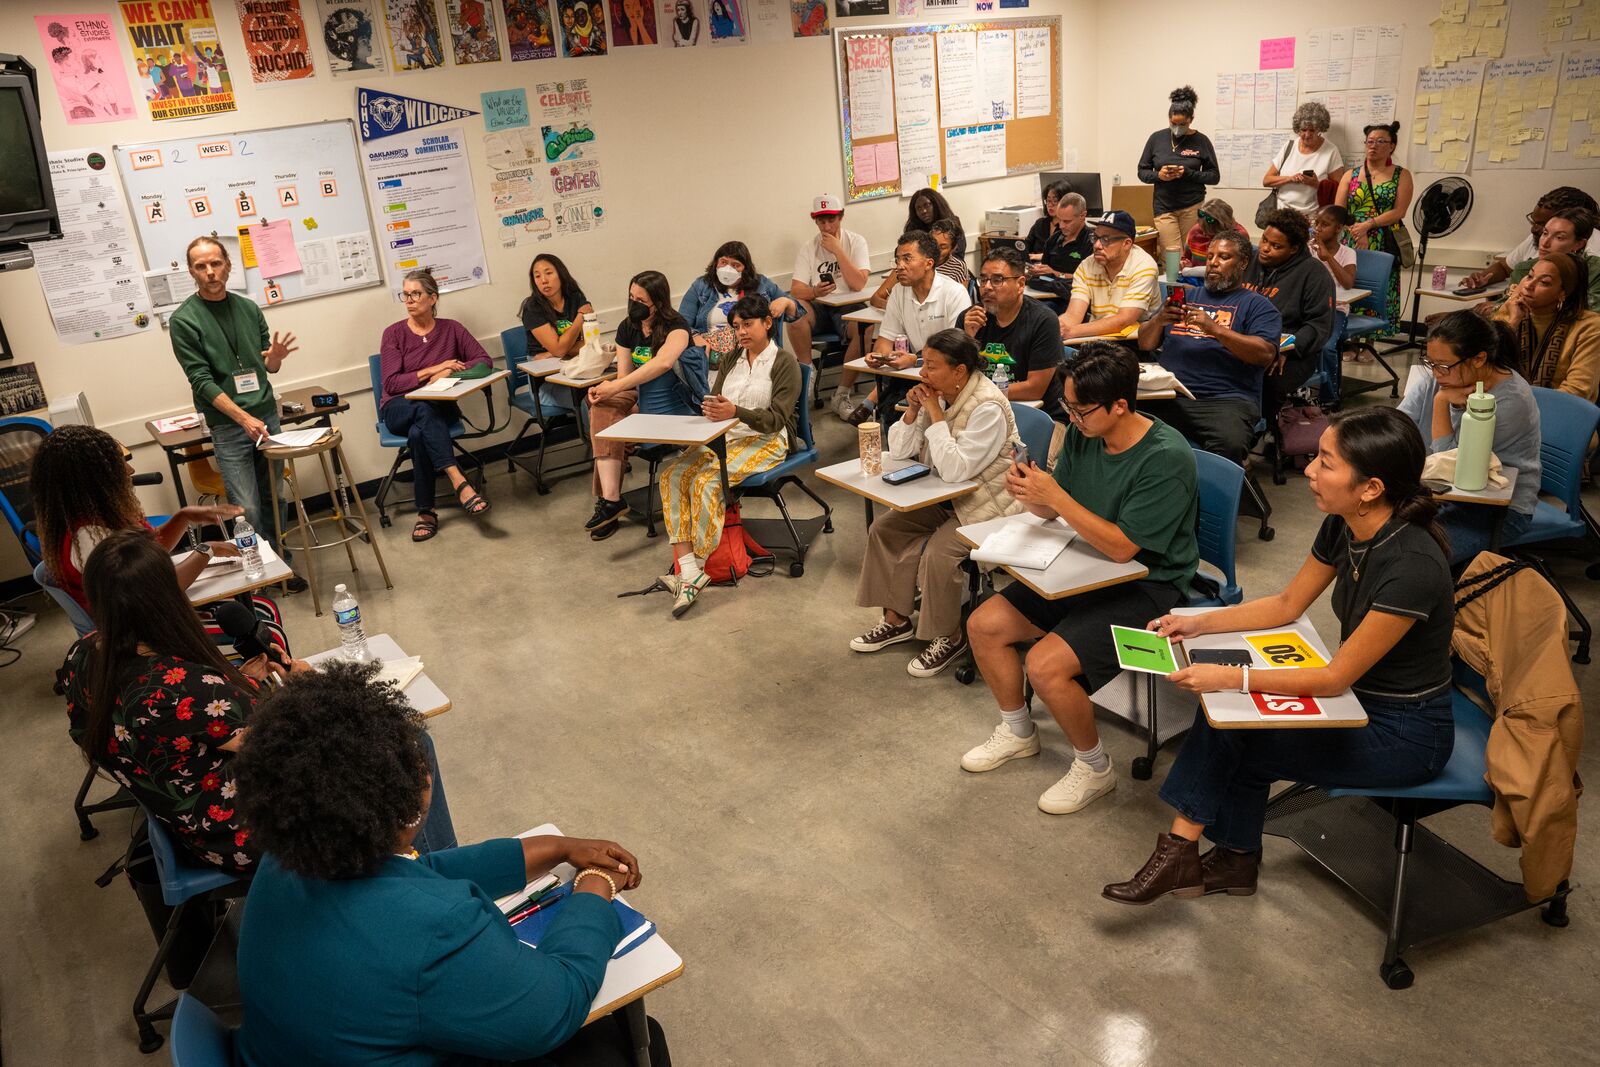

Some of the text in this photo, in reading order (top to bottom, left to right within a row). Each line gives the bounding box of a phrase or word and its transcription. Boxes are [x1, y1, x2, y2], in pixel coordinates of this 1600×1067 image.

[122, 0, 209, 24] WE CAN'T
[243, 0, 293, 14] WELCOME
[976, 2, 993, 11] NOW
[75, 20, 108, 31] ETHNIC
[255, 15, 289, 28] TO THE
[80, 29, 111, 37] STUDIES
[129, 22, 185, 48] WAIT
[247, 26, 300, 42] TERRITORY
[272, 42, 283, 52] OF
[512, 50, 556, 60] ABORTION
[151, 93, 232, 110] INVEST IN THE SCHOOLS
[152, 101, 236, 119] OUR STUDENTS DESERVE
[360, 91, 370, 138] OHS
[404, 98, 471, 129] WILDCATS
[422, 135, 450, 146] SCHOLAR
[201, 145, 228, 154] WEEK:
[238, 140, 254, 156] 2
[415, 142, 459, 155] COMMITMENTS
[138, 154, 156, 163] MP:
[171, 149, 188, 164] 2
[368, 149, 399, 159] OAKLAND
[274, 172, 297, 181] Thursday
[184, 186, 206, 194] Tuesday
[227, 180, 256, 189] Wednesday
[323, 183, 334, 194] B
[141, 193, 163, 201] Monday
[284, 191, 295, 203] A
[194, 201, 206, 213] B
[240, 201, 251, 212] B
[1122, 643, 1156, 654] 1
[1262, 644, 1305, 664] 30
